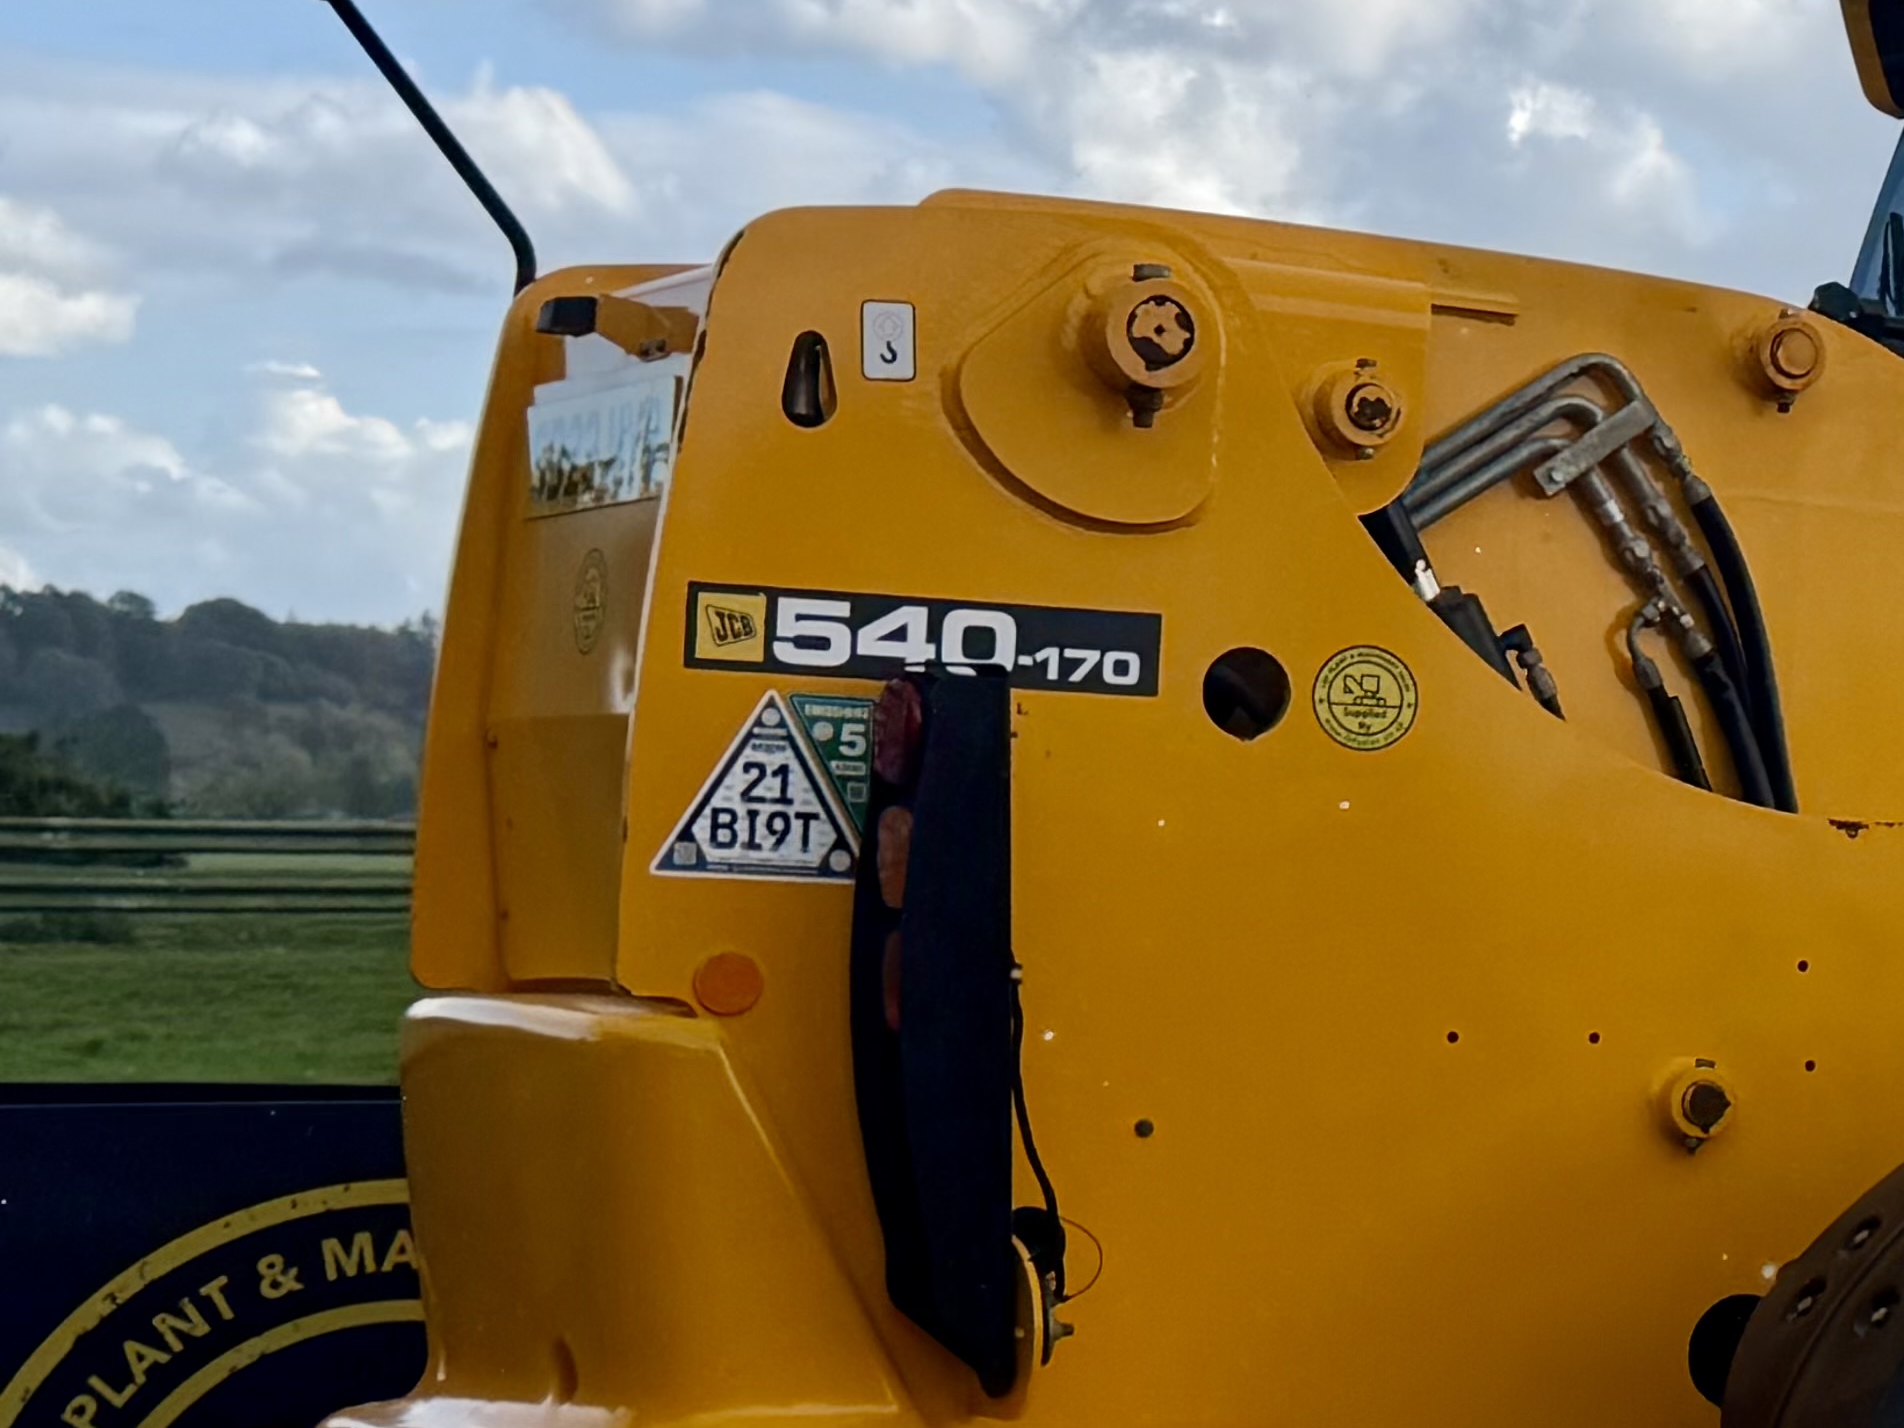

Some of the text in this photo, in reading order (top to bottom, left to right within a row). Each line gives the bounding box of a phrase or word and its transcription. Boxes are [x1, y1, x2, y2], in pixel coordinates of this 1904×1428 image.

[713, 609, 754, 642] JCB
[773, 596, 1141, 686] 540-170
[838, 723, 867, 757] 5
[740, 760, 794, 806] 21
[256, 1253, 305, 1300] &
